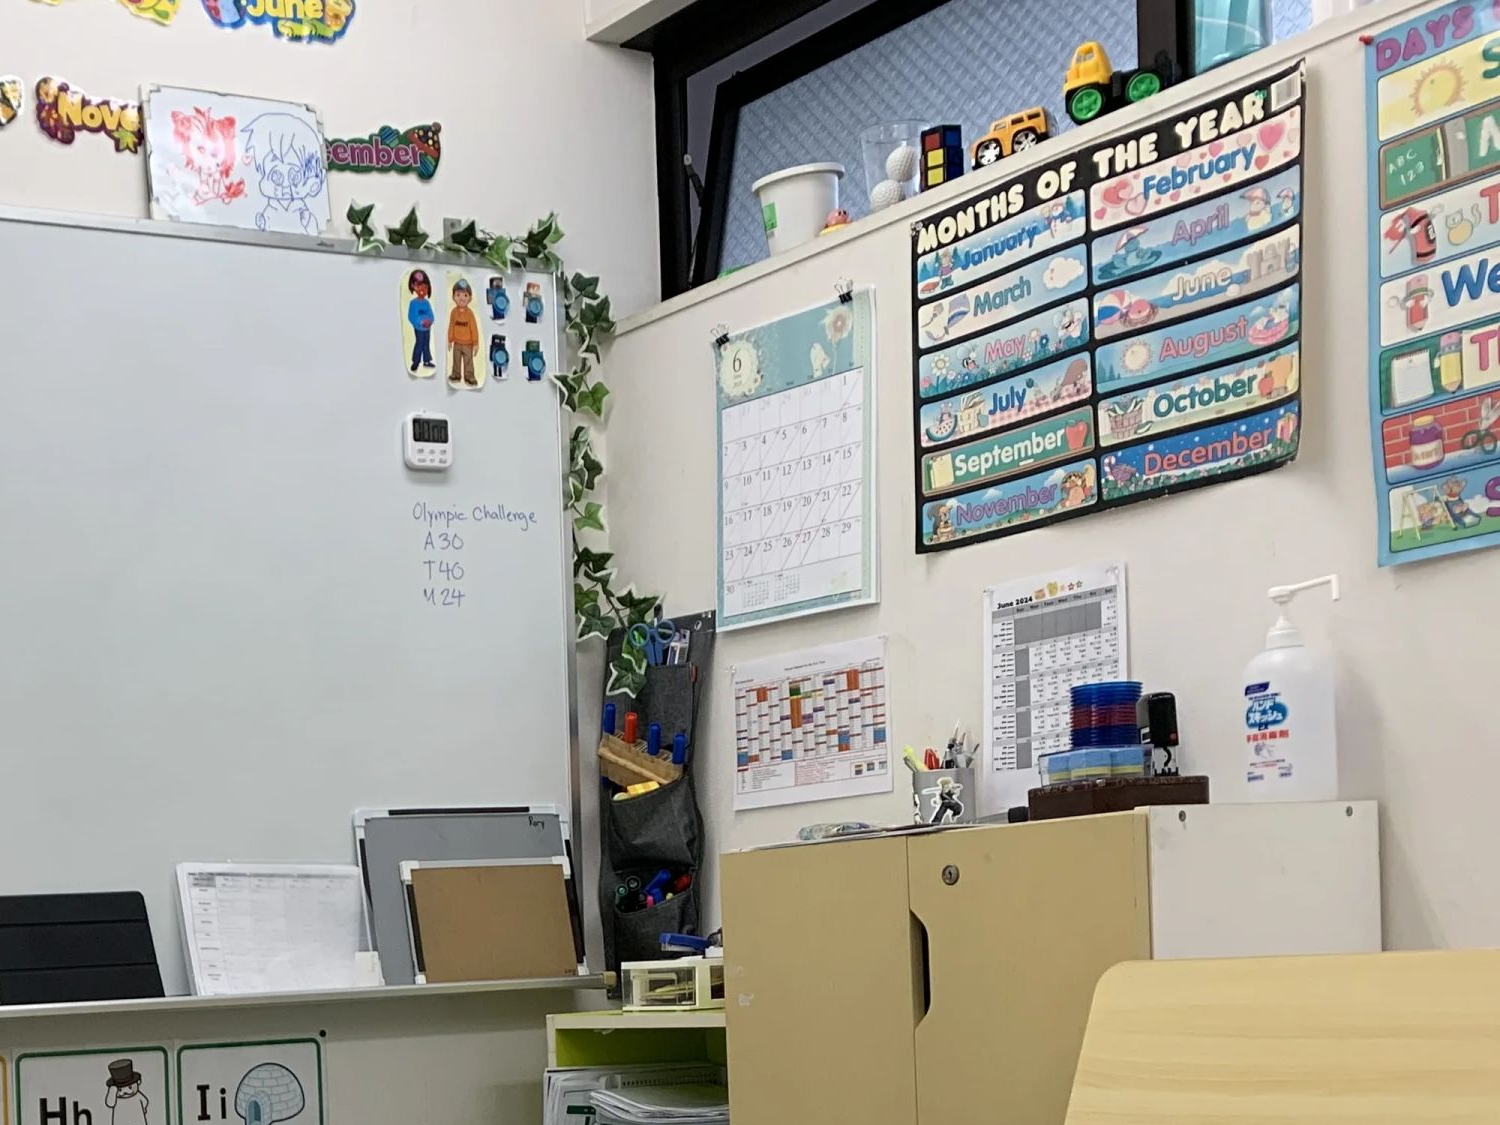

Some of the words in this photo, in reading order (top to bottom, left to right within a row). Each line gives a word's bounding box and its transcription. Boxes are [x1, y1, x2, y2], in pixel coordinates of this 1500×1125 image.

[1375, 4, 1474, 72] DAYS
[326, 136, 421, 167] ember
[916, 183, 1024, 254] MONTHS
[1037, 161, 1077, 200] OF
[1092, 133, 1158, 181] THE
[1174, 92, 1266, 149] YEAR
[1143, 142, 1258, 201] February
[960, 223, 1038, 271] January
[1171, 204, 1230, 248] April
[973, 275, 1032, 317] March
[1172, 264, 1234, 302] June
[732, 349, 742, 373] 6
[983, 334, 1027, 365] May
[1157, 315, 1248, 364] August
[988, 384, 1028, 418] July
[1152, 371, 1258, 419] October
[743, 476, 752, 486] 10
[763, 470, 771, 481] 11
[782, 464, 792, 476] 12
[803, 459, 812, 470] 13
[822, 454, 832, 464] 14
[842, 448, 852, 460] 15
[954, 427, 1065, 476] September
[1144, 425, 1272, 477] December
[412, 502, 468, 529] Olympic
[471, 504, 538, 532] Challenge
[743, 510, 752, 521] 17
[763, 505, 772, 517] 18
[782, 500, 792, 512] 19
[802, 496, 812, 507] 20
[822, 490, 830, 502] 21
[842, 484, 852, 496] 22
[956, 483, 1059, 527] November
[725, 550, 734, 561] 23
[743, 546, 753, 556] 24
[763, 541, 772, 552] 25
[782, 536, 792, 548] 26
[802, 532, 811, 543] 27
[822, 527, 831, 538] 28
[842, 522, 852, 534] 29
